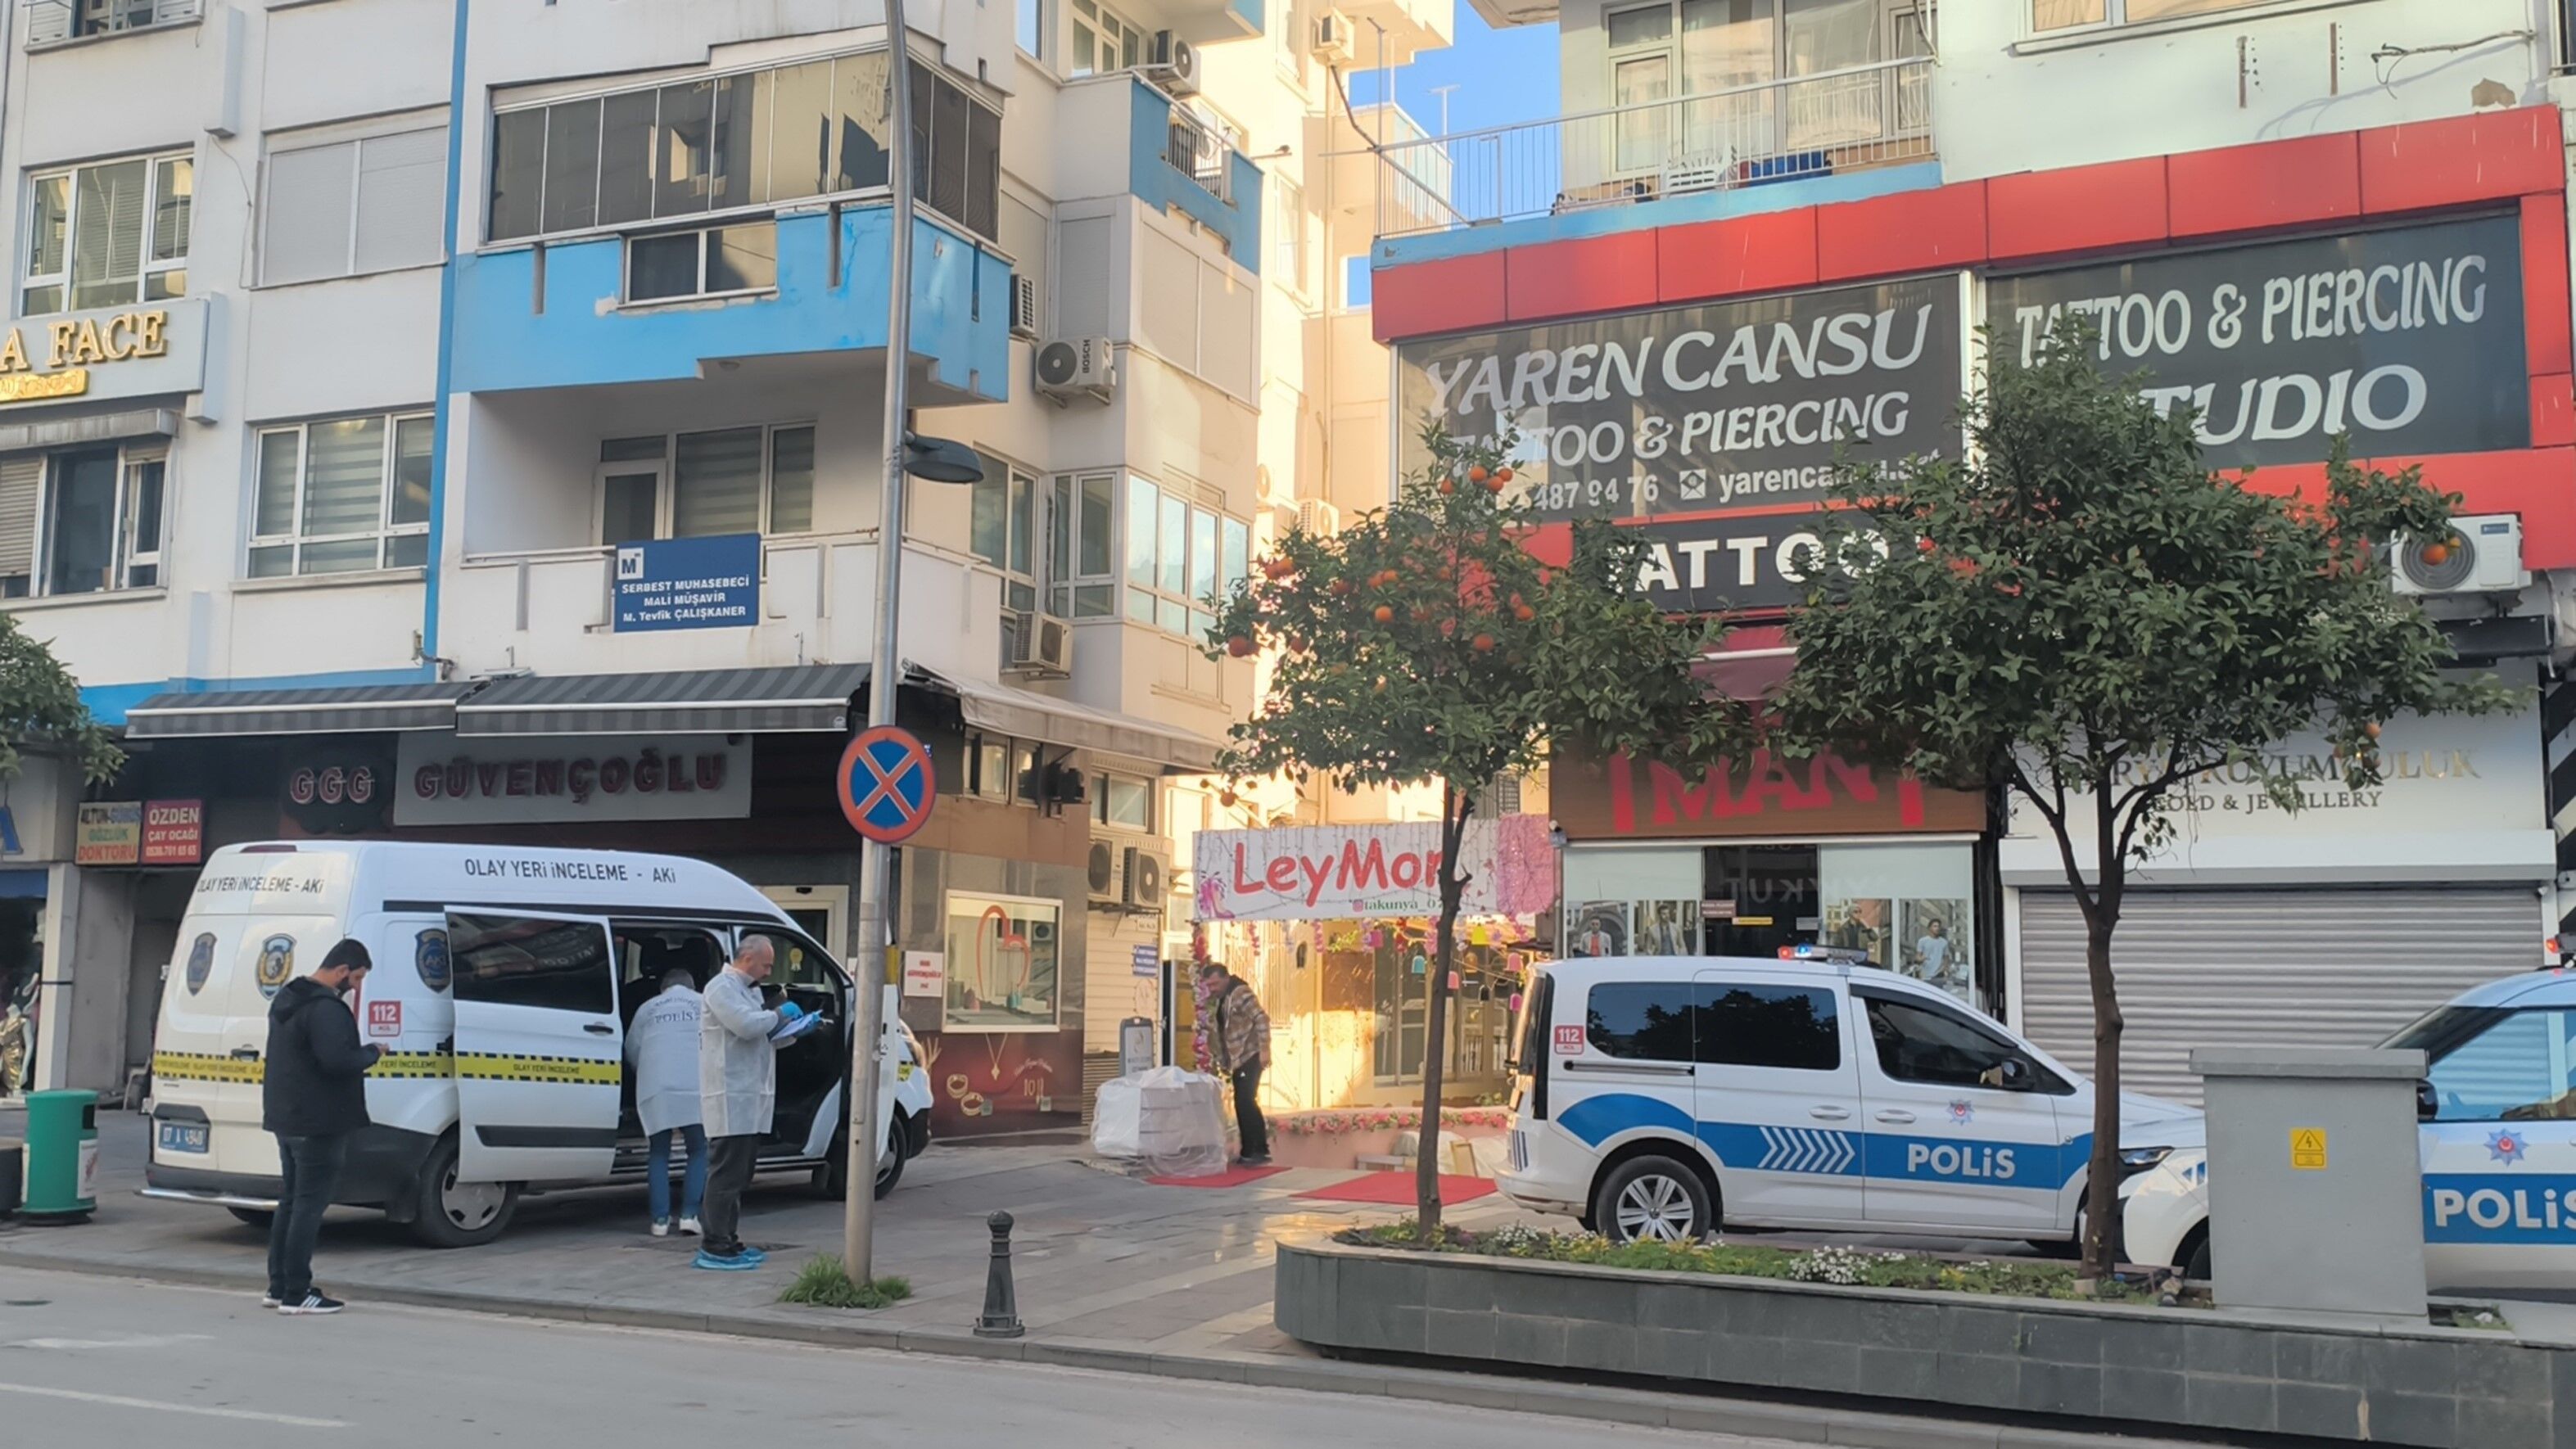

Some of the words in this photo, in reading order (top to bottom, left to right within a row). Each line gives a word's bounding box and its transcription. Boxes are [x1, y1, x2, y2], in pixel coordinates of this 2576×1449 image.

[2208, 283, 2247, 349] &
[2262, 254, 2486, 345] PIERCING
[47, 309, 167, 368] FACE
[1426, 336, 1655, 420] YAREN
[1662, 305, 1932, 392] CANSU
[2124, 363, 2428, 446] TUDIO
[1450, 420, 1625, 478] TTOO
[1633, 415, 1674, 459] &
[1681, 391, 1909, 456] PIERCING
[1588, 477, 1620, 507] 94
[1627, 474, 1659, 503] 76
[1607, 528, 1889, 594] ATTOO
[621, 581, 671, 594] SERBEST
[674, 574, 750, 590] MUHASEBECİ
[644, 593, 671, 607] MALİ
[674, 589, 725, 607] MÜŞAVİR
[639, 610, 671, 621] Tevfik
[674, 605, 746, 622] ÇALIŞKANER
[290, 765, 375, 805] GGG
[414, 747, 729, 805] GÜVENÇOĞLU
[149, 805, 200, 825] ÖZDEN
[2222, 794, 2239, 810] &
[2245, 791, 2383, 815] JELLERY
[147, 830, 167, 842] ÇAY
[169, 828, 198, 840] OCAĞI
[464, 859, 507, 877] OLAY
[510, 860, 548, 878] YERİ
[550, 860, 628, 882] İNCELEME
[373, 1004, 397, 1022] 112
[1558, 1028, 1579, 1043] 112
